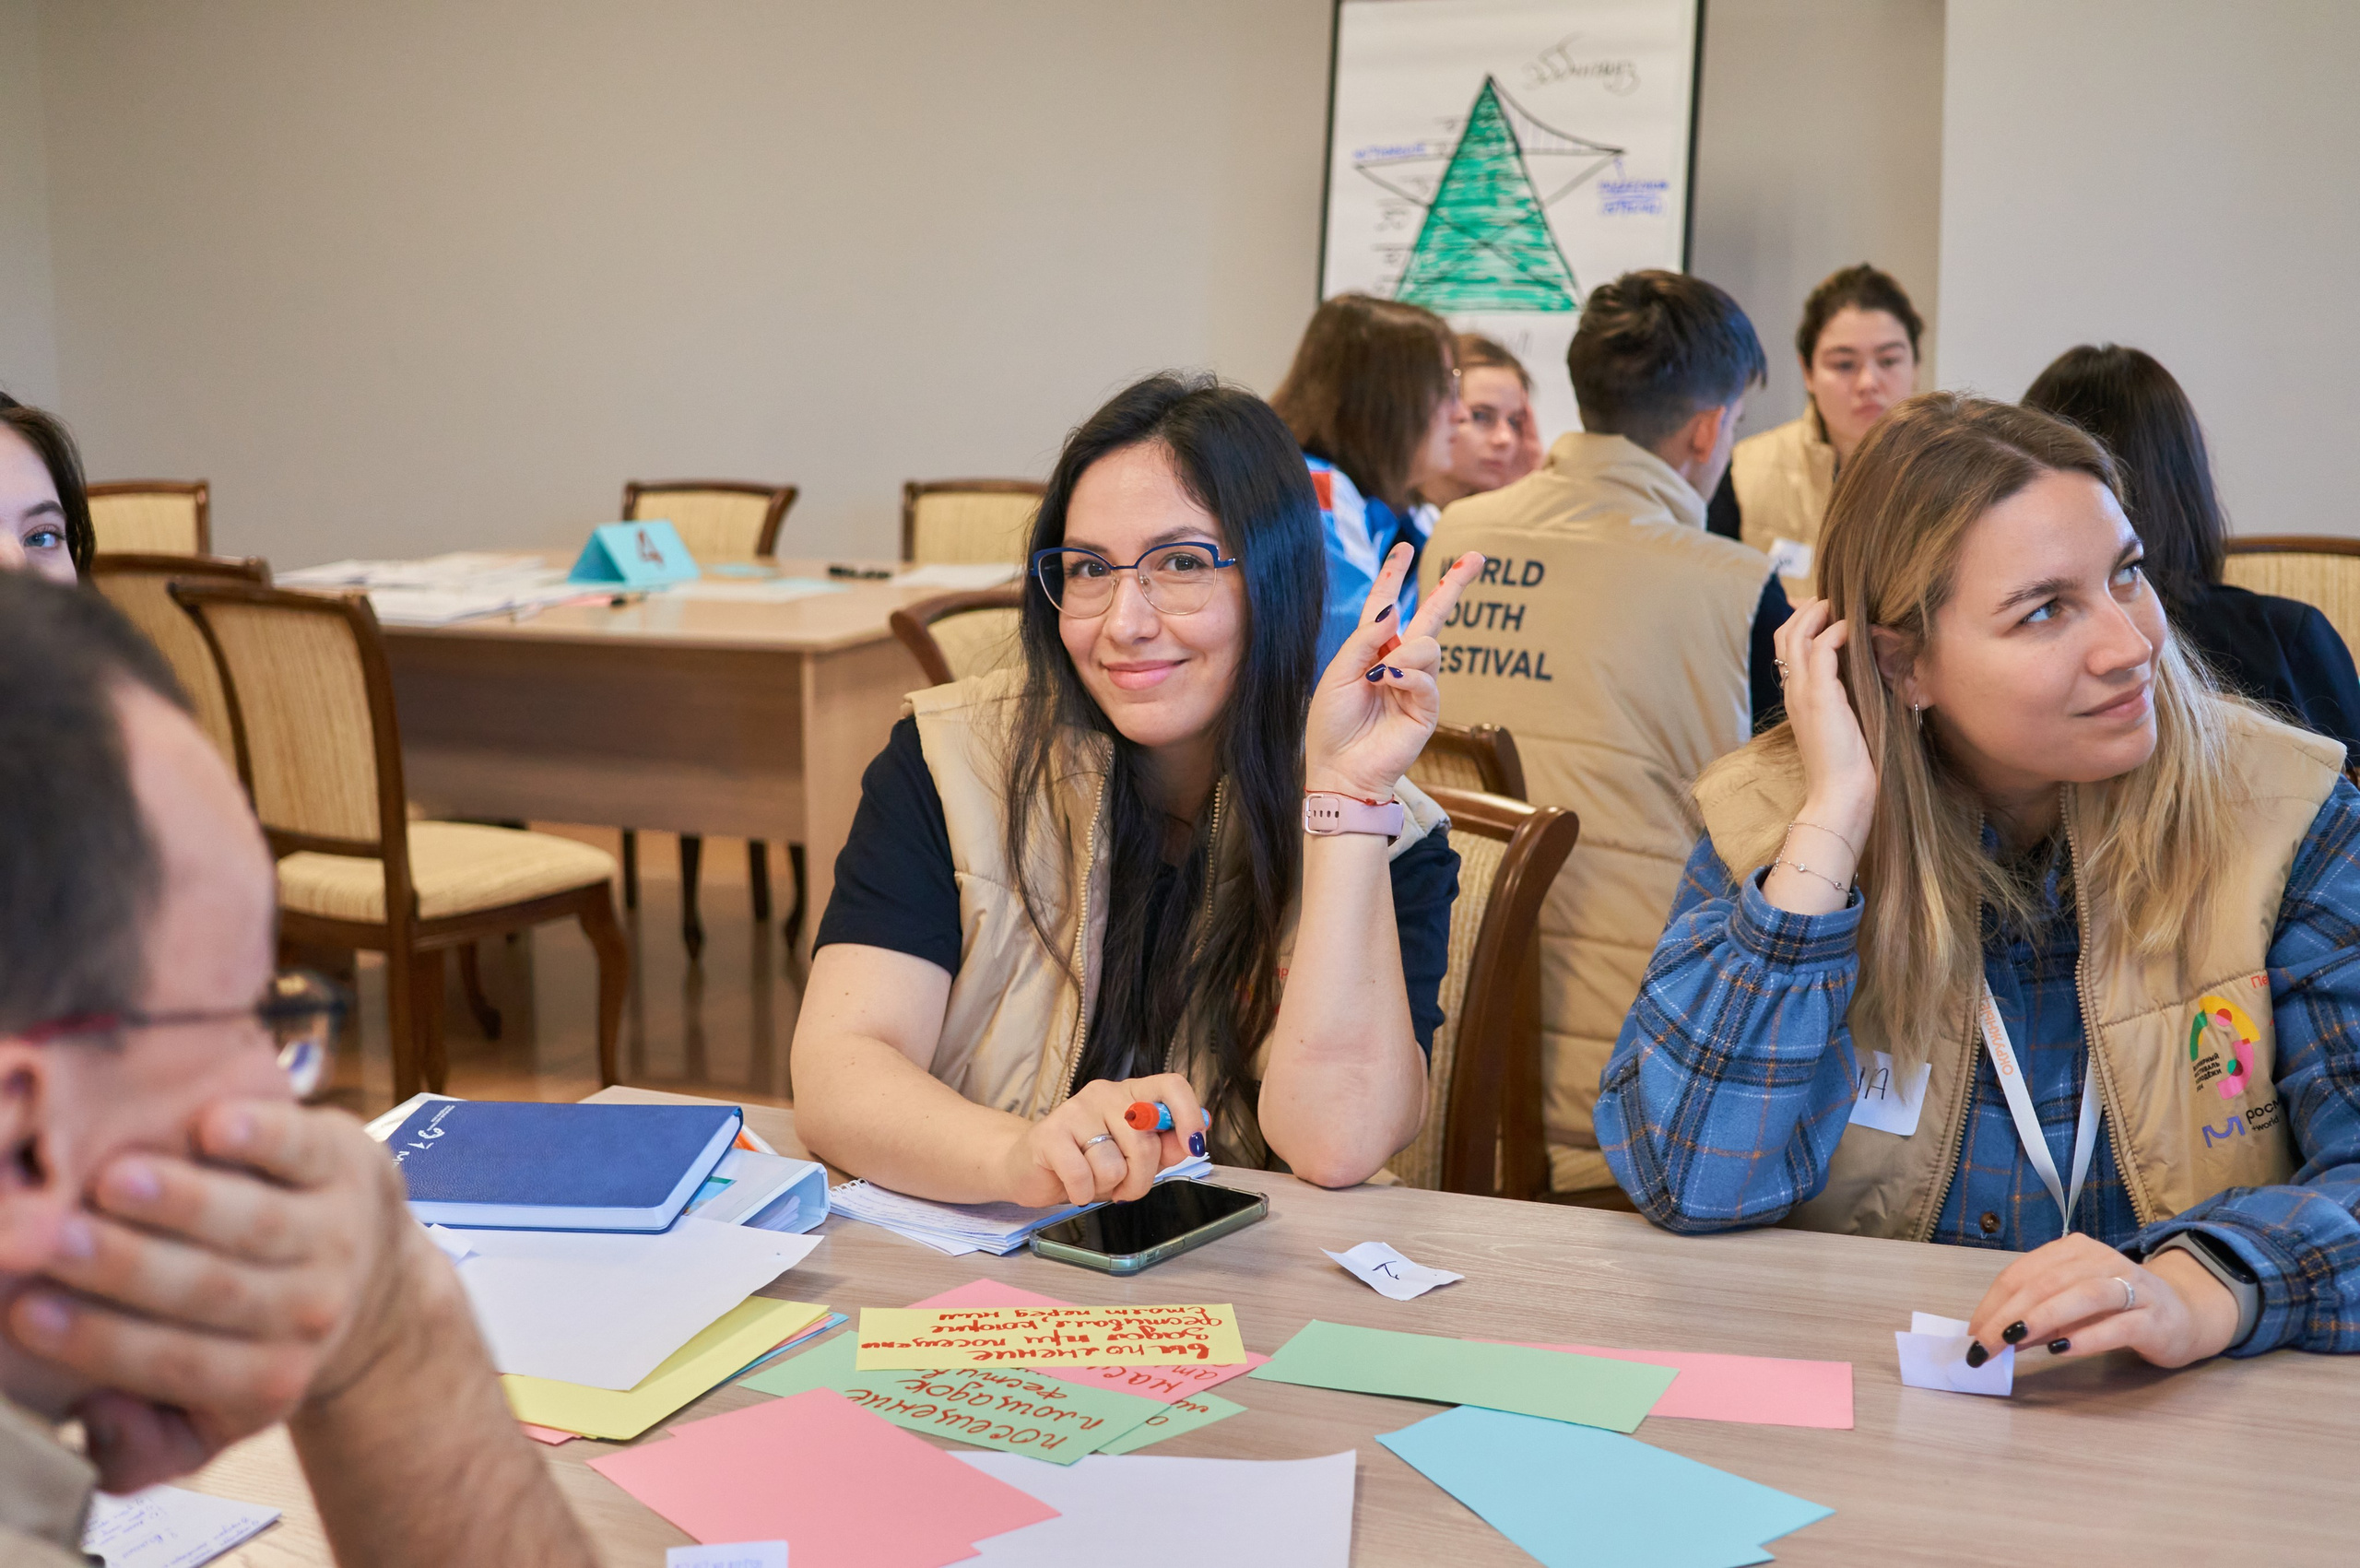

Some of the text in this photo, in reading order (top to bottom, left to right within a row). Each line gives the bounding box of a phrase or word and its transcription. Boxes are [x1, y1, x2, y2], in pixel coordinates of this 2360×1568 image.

[1441, 557, 1545, 587] RLD
[1445, 601, 1526, 631] OUTH
[1439, 646, 1552, 681] ESTIVAL
[913, 1368, 1068, 1400] фестив
